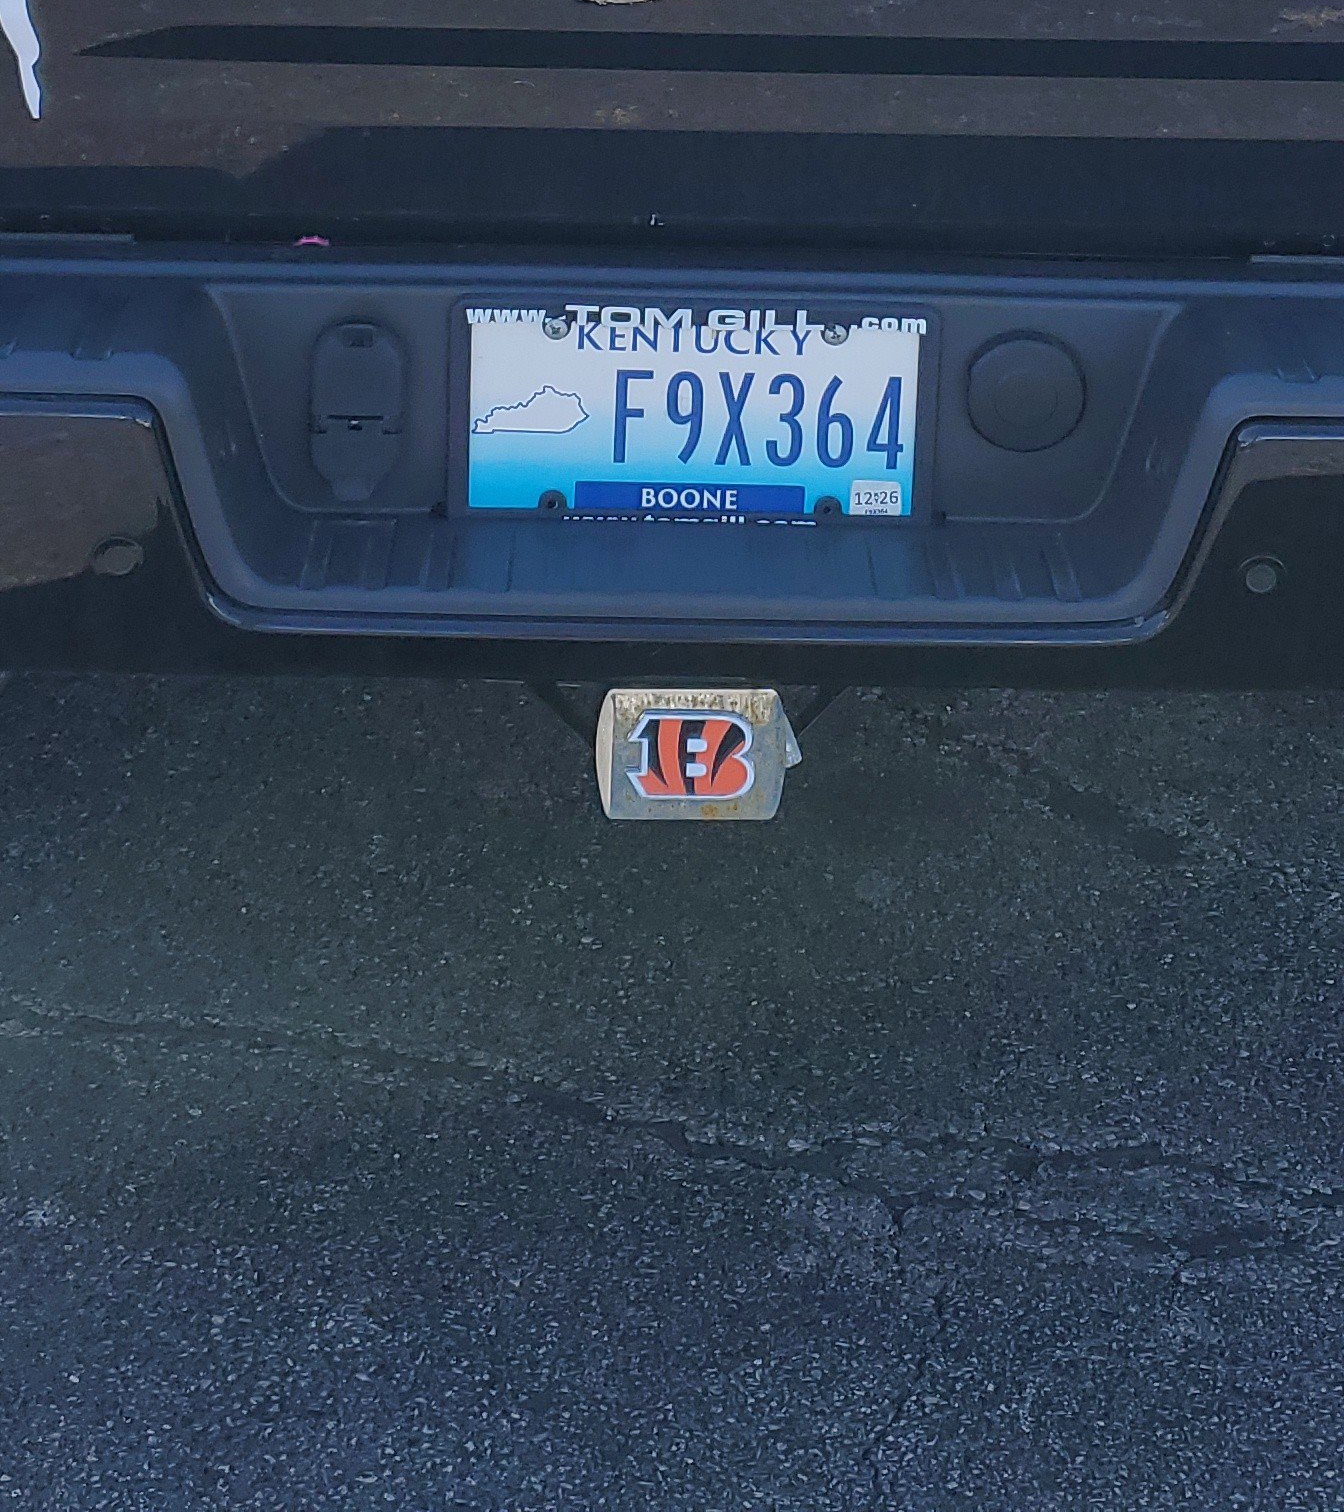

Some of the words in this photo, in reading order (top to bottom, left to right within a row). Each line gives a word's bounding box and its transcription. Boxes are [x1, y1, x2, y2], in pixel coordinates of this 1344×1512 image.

[565, 304, 692, 331] TOM
[707, 309, 825, 332] GILL
[576, 322, 811, 356] KENTUCKY
[612, 369, 904, 470] F9X364
[641, 487, 738, 510] BOONE
[854, 491, 873, 505] 12
[879, 490, 899, 504] 26
